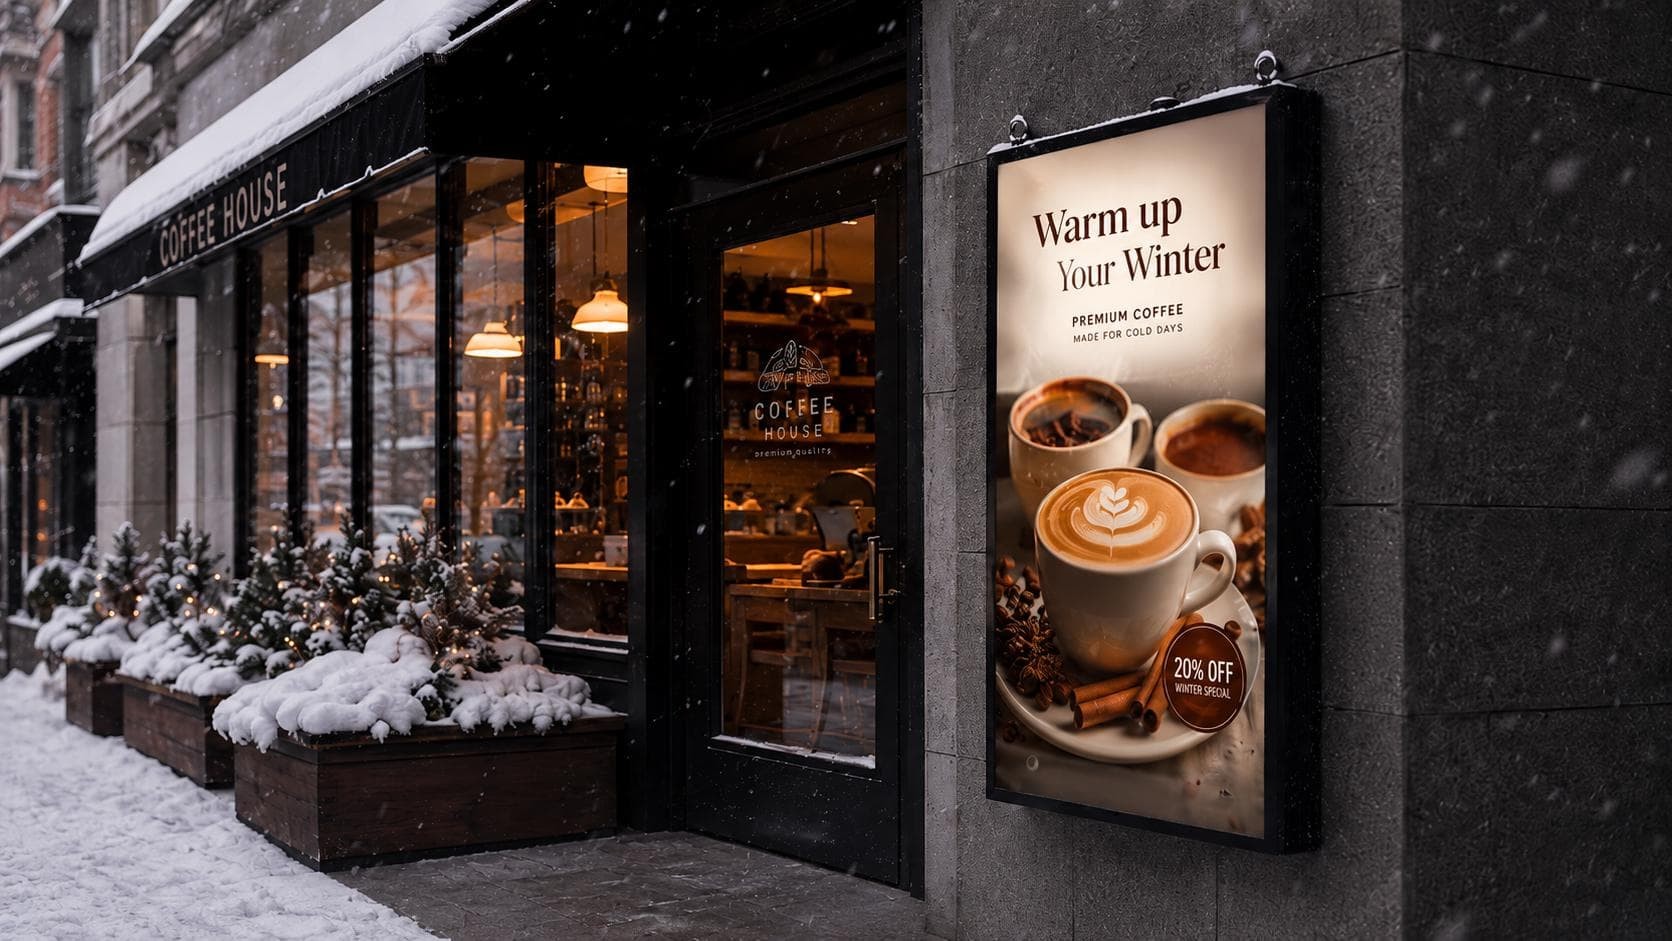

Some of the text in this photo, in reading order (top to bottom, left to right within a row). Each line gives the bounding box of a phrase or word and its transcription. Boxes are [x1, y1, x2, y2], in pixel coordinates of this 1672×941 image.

[160, 163, 287, 267] COFFEE HOUSE
[1032, 196, 1183, 247] Warm up
[1057, 242, 1226, 292] Your Winter
[1072, 303, 1184, 328] PREMIUM COFFEE
[1073, 323, 1183, 343] MADE FOR COLD DAYS
[755, 396, 834, 420] COFFEE
[764, 424, 822, 441] HOUSE
[1174, 656, 1234, 684] 20% OFF
[1175, 682, 1203, 695] WINTER
